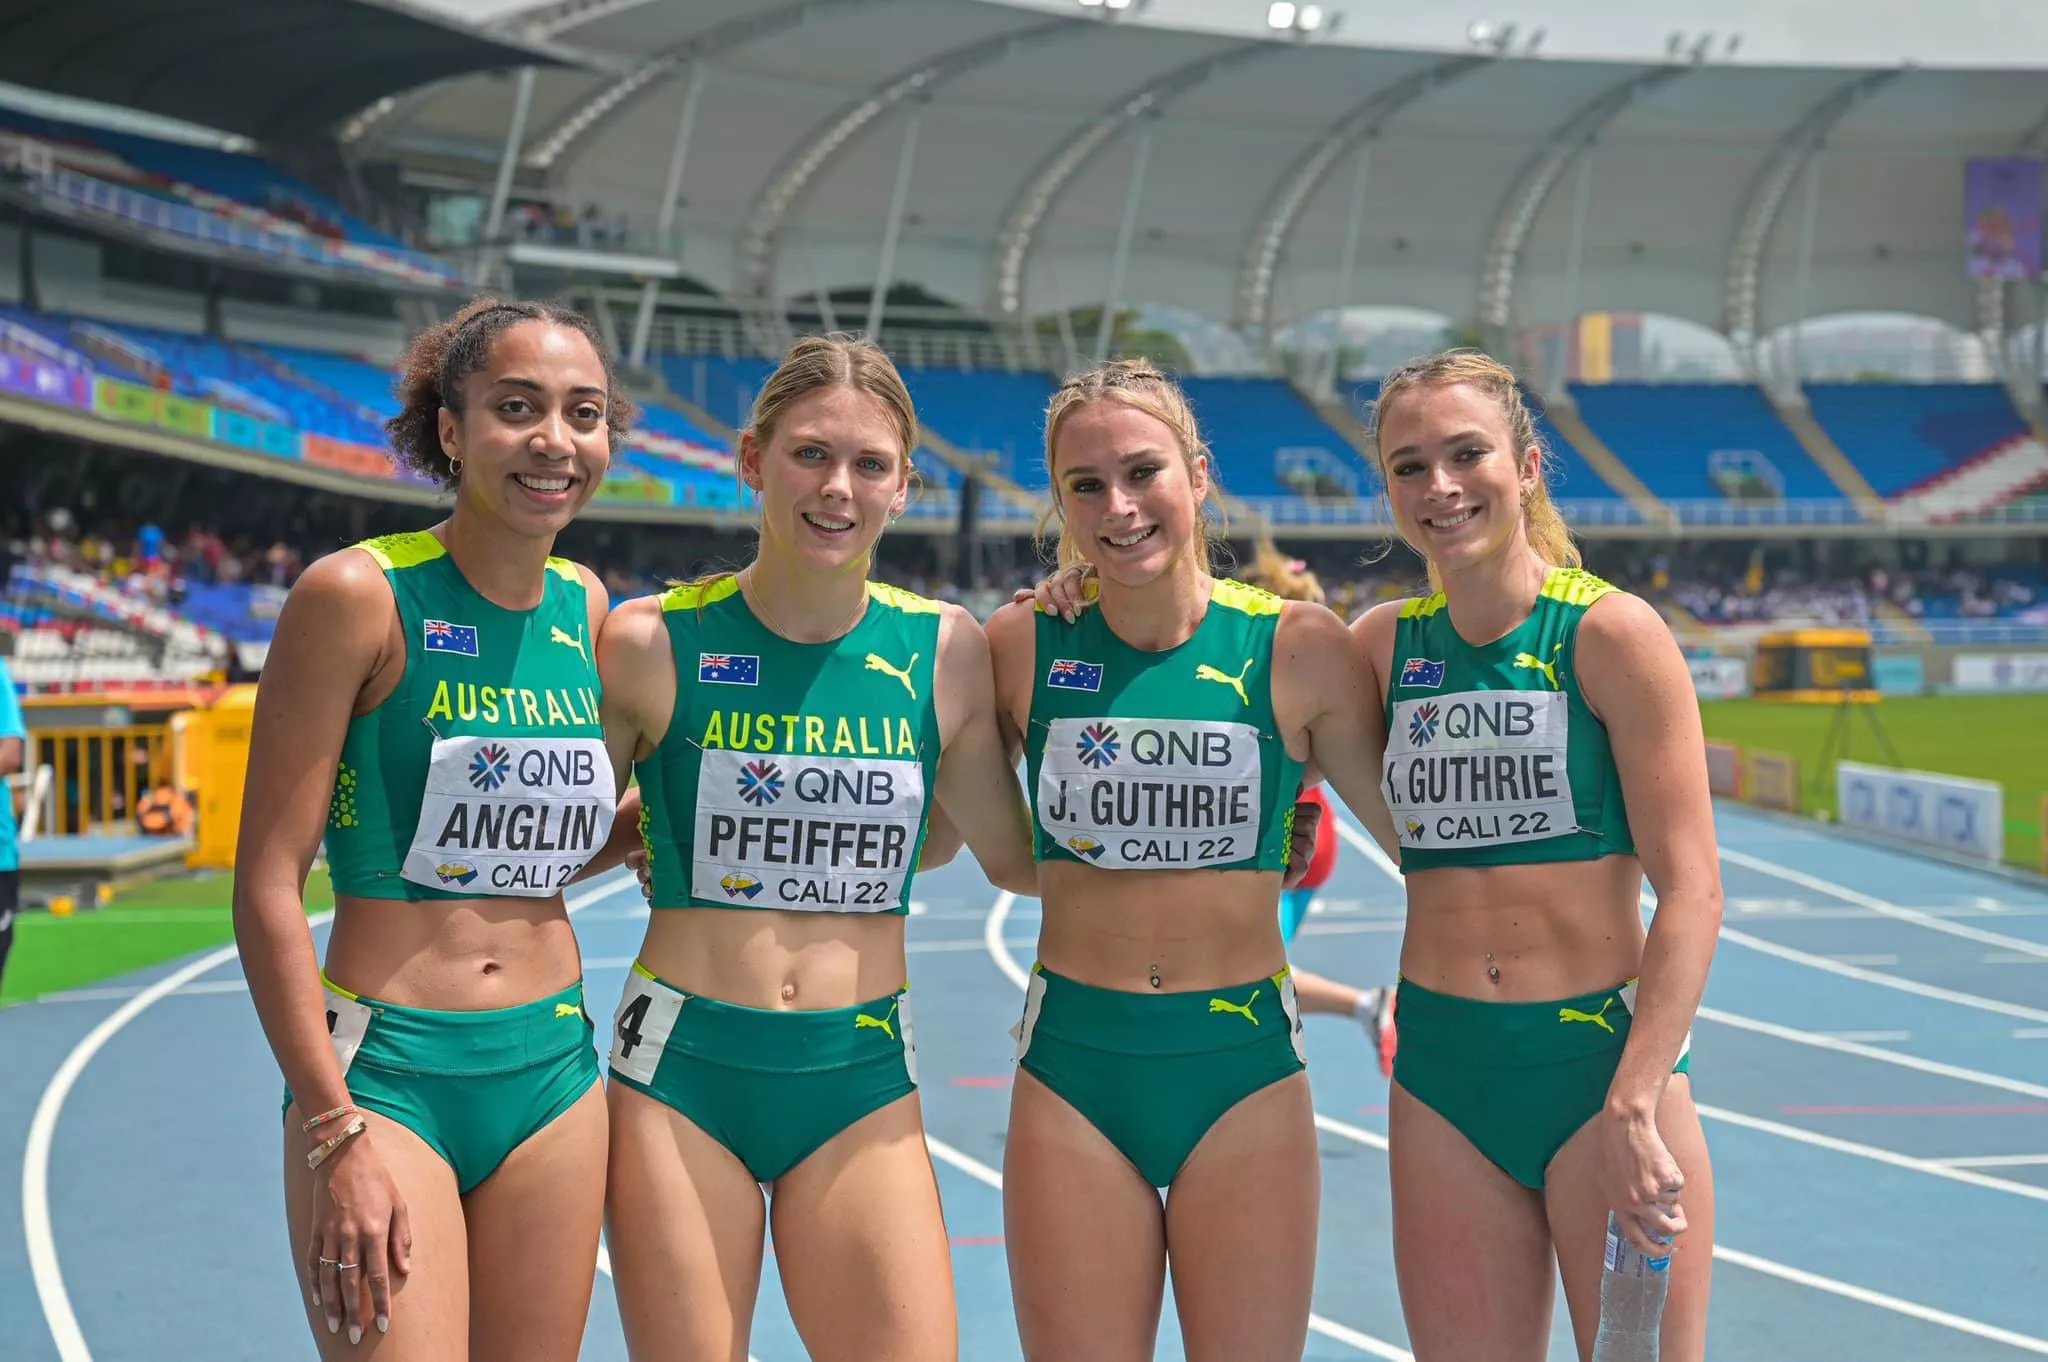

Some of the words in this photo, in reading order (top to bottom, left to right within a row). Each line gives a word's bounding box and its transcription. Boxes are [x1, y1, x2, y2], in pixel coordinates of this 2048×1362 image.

[701, 710, 916, 755] AUSTRALIA
[1445, 701, 1534, 739] QNB
[1131, 729, 1232, 767] QNB
[518, 749, 595, 787] QNB
[794, 767, 894, 805] QNB
[1409, 755, 1558, 804] GUTHRIE
[1049, 780, 1077, 822] J.
[1091, 780, 1249, 828] GUTHRIE
[436, 803, 598, 851] ANGLIN
[709, 814, 906, 869] PFEIFFER
[1436, 815, 1501, 840] CALI
[1508, 812, 1551, 836] 22
[1120, 839, 1188, 862] CALI
[1198, 836, 1235, 861] 22
[491, 864, 552, 888] CALI
[778, 878, 847, 904] CALI
[853, 881, 889, 904] 22
[617, 994, 653, 1060] 4
